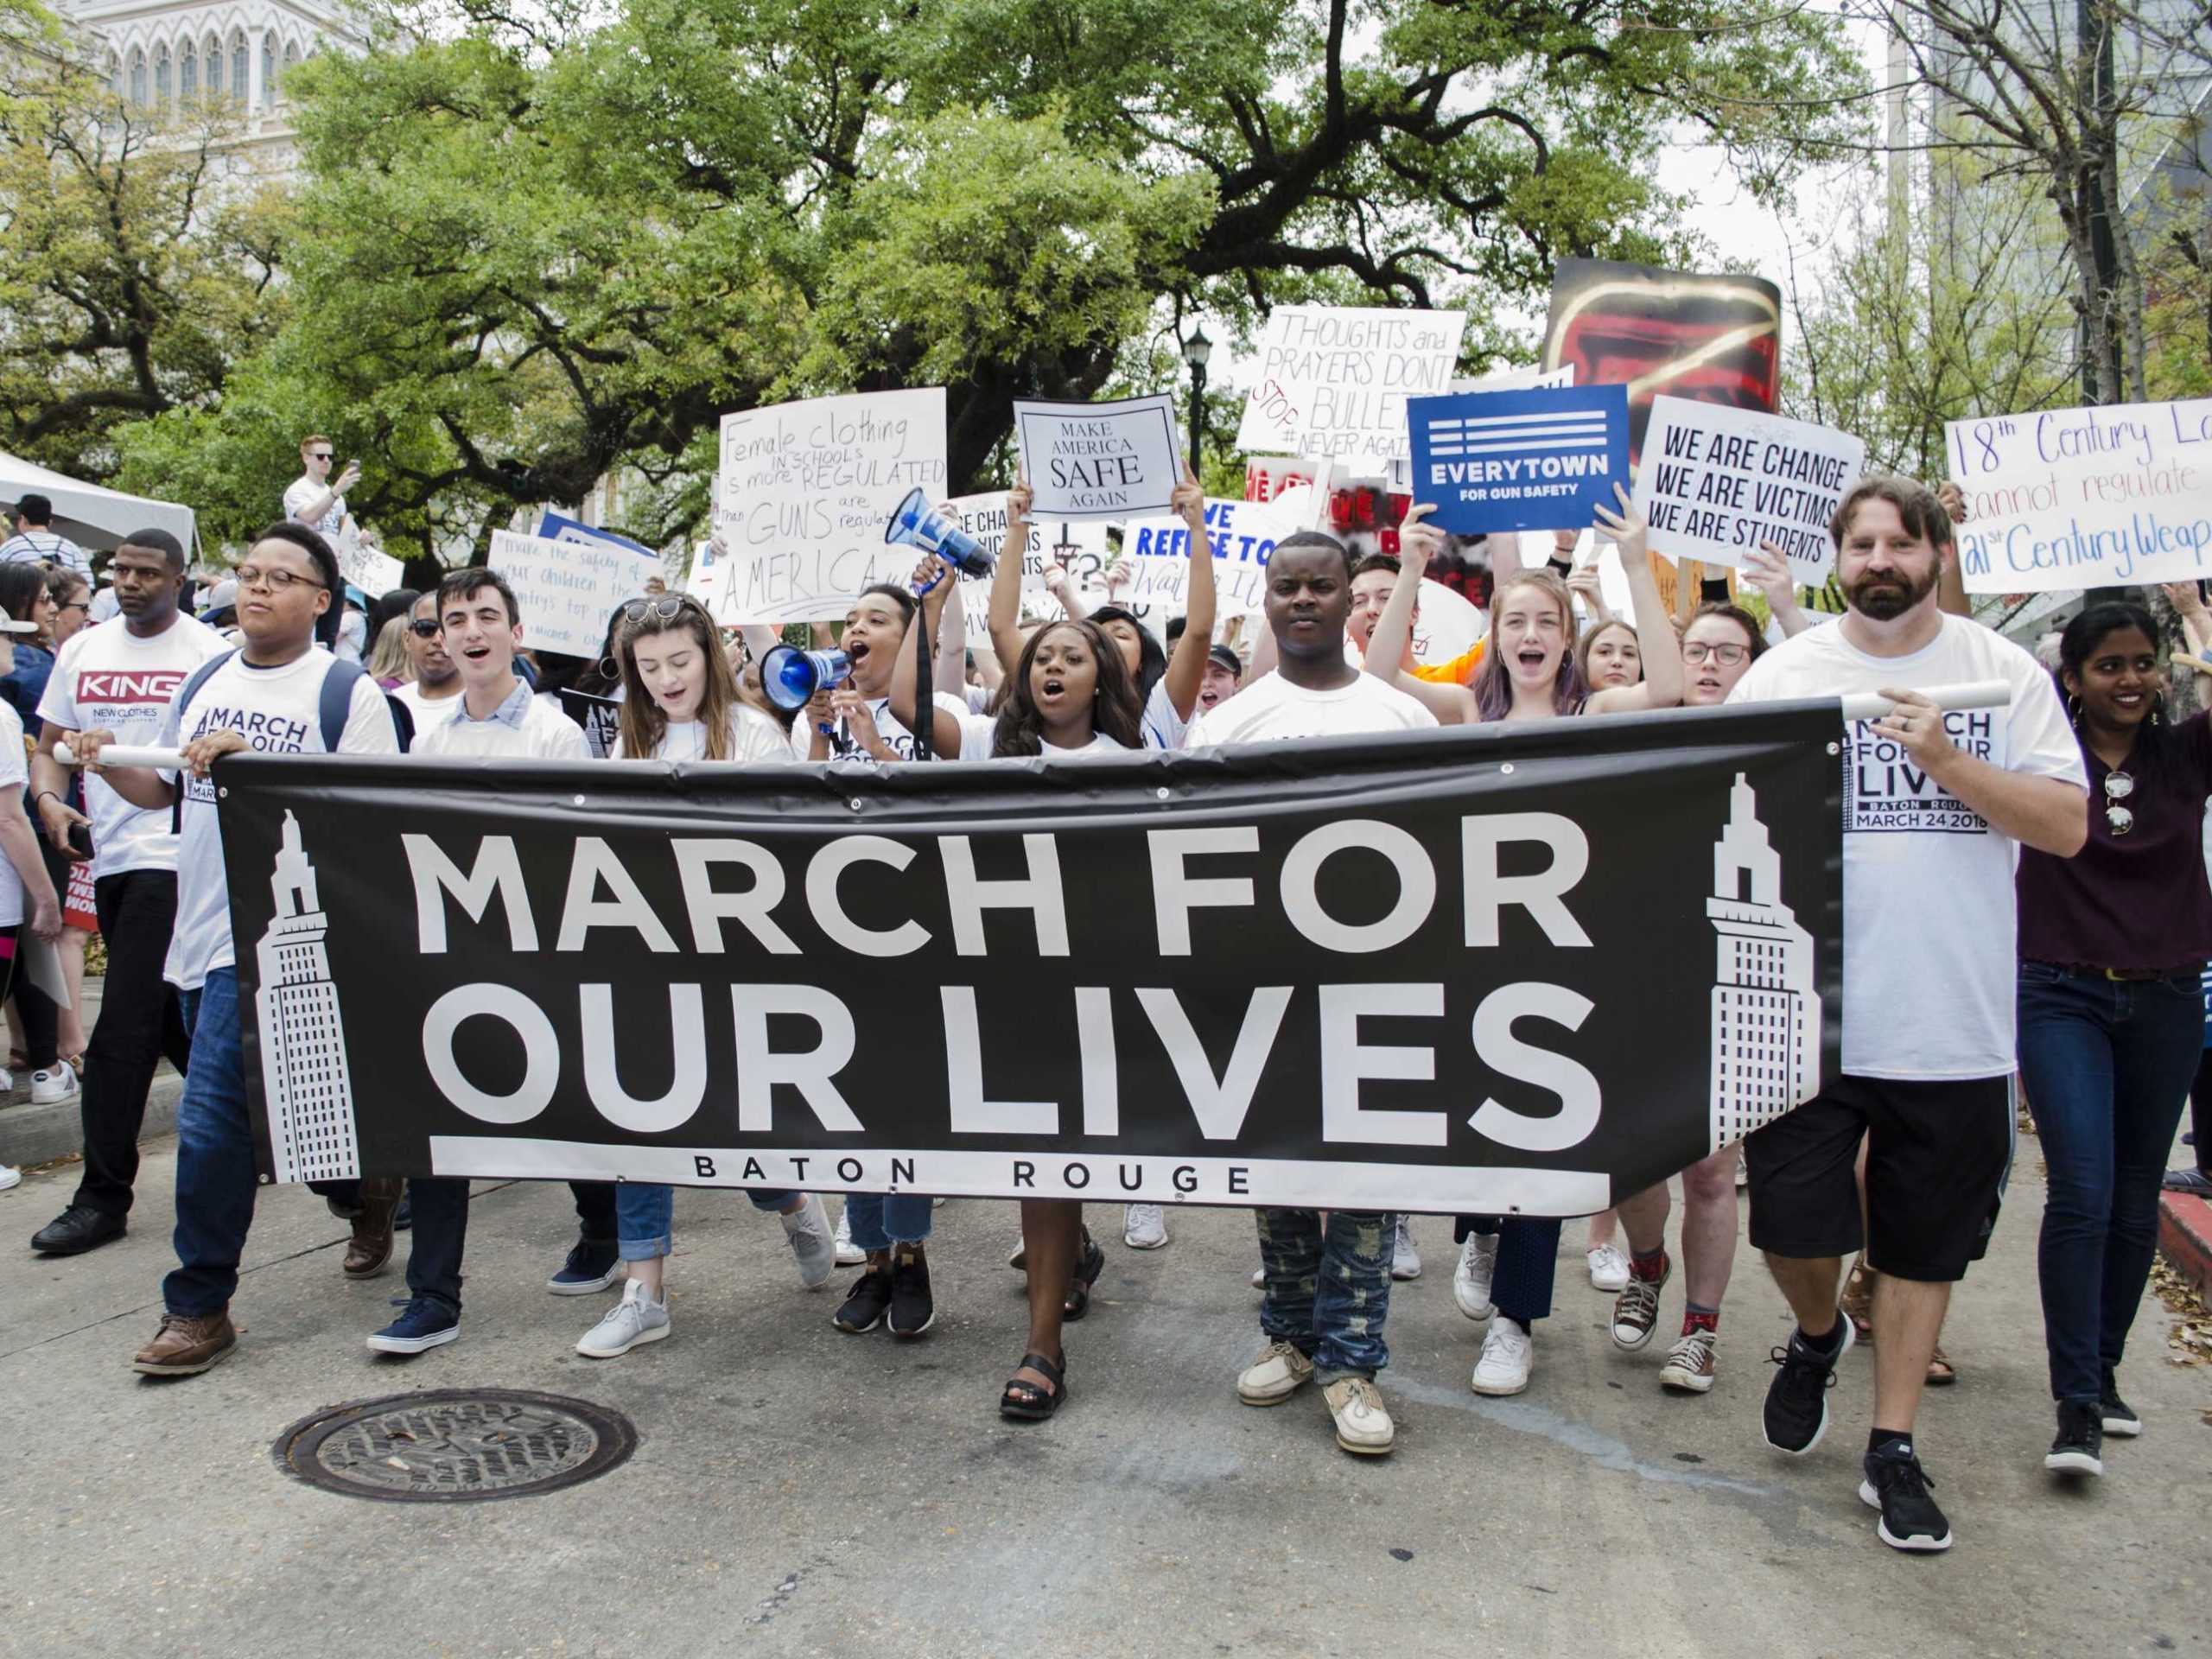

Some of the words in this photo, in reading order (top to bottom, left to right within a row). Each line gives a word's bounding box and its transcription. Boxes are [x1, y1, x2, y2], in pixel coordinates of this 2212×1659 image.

[1281, 314, 1410, 349] THOUGHTS
[1413, 331, 1447, 351] and
[1263, 346, 1375, 385] PRAYERS
[1383, 353, 1454, 391] DONT
[1252, 378, 1299, 429] STOP
[1310, 386, 1436, 430] BULLE
[726, 416, 795, 465] Female
[809, 409, 907, 459] clothing
[1052, 438, 1133, 455] AMERICA
[1060, 421, 1113, 437] MAKE
[1363, 435, 1410, 457] AGAI
[2037, 410, 2153, 466] Century
[747, 469, 792, 488] more
[803, 459, 946, 492] REGULATED
[772, 454, 785, 470] IN
[794, 448, 863, 469] SCHOOLS
[1051, 454, 1144, 489] SAFE
[1430, 454, 1609, 485] EVERYTOWN
[1664, 424, 1703, 461] WE
[1706, 434, 1759, 471] ARE
[1763, 443, 1848, 492] CHANGE
[1069, 491, 1128, 508] AGAIN
[1459, 489, 1487, 501] FOR
[1490, 486, 1521, 499] GUN
[1523, 483, 1579, 499] SAFETY
[1655, 462, 1694, 499] WE
[1697, 472, 1749, 509] ARE
[1755, 481, 1838, 529] VICTIMS
[1964, 472, 2060, 524] cannot
[2082, 455, 2201, 503] regulate
[747, 499, 833, 545] GUNS
[838, 496, 871, 509] are
[839, 511, 893, 537] regulat
[1647, 500, 1681, 532] WE
[1685, 509, 1729, 543] ARE
[1732, 518, 1826, 563] STUDENTS
[1238, 535, 1275, 567] TO
[2006, 518, 2133, 578] Century
[81, 674, 182, 699] KING
[92, 709, 117, 718] NEW
[211, 707, 308, 744] MARCH
[1856, 712, 1991, 741] MCH
[1859, 764, 1949, 797] LIV
[1857, 812, 1920, 827] MARCH
[1925, 813, 1947, 827] 24
[1950, 813, 1988, 829] 2018
[1869, 800, 1920, 811] BATON
[1930, 800, 1967, 811] ROU
[400, 832, 1071, 957] MARCH
[1147, 810, 1595, 957] FOR
[422, 982, 866, 1133] OUR
[939, 981, 1603, 1153] LIVES
[693, 1155, 916, 1185] BATON
[1012, 1160, 1249, 1195] ROUGE
